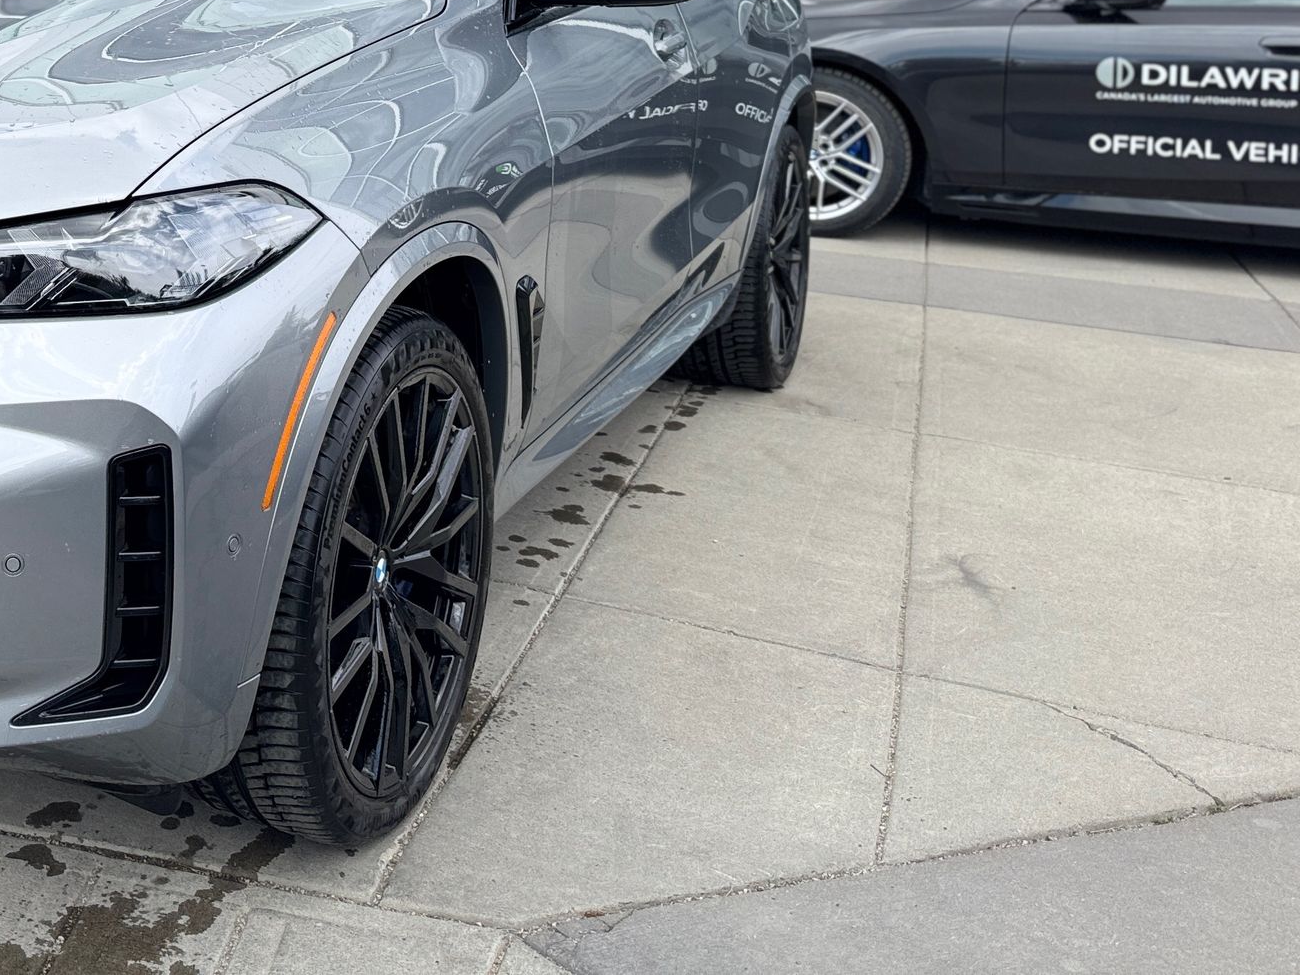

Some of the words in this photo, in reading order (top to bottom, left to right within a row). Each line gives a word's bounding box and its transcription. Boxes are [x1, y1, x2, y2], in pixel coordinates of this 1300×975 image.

[1141, 63, 1299, 92] DILAWRI
[1147, 93, 1191, 104] LARGEST
[1193, 95, 1258, 107] AUTOMOTIVE
[1260, 97, 1298, 108] GROUP
[1089, 132, 1221, 160] OFFICIAL
